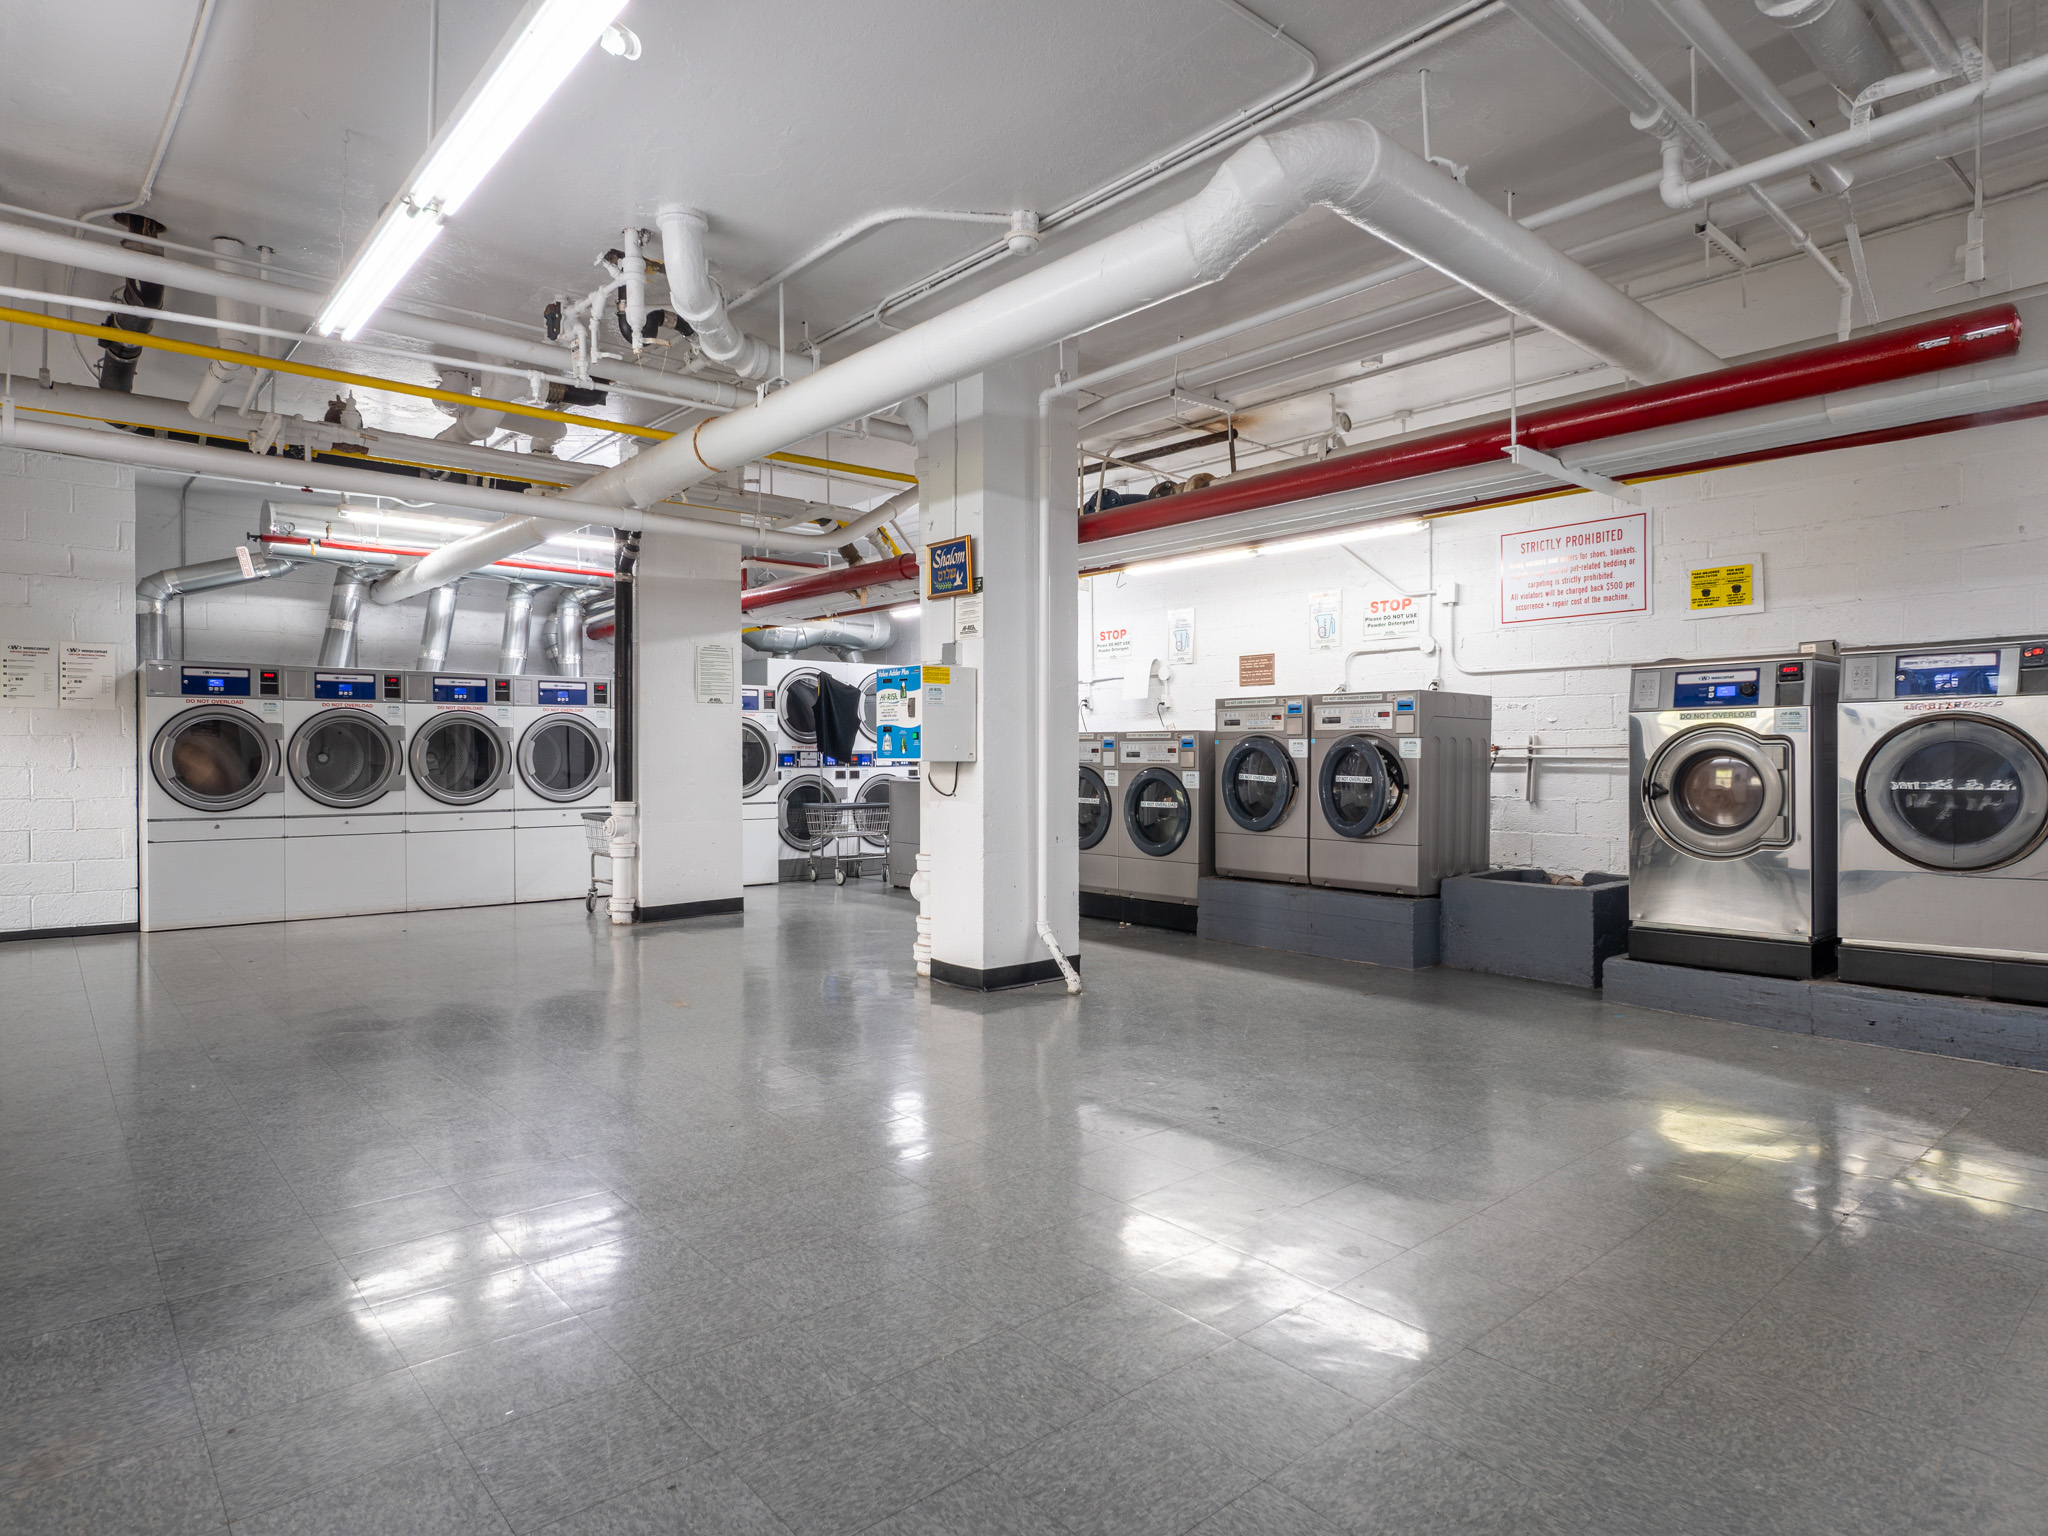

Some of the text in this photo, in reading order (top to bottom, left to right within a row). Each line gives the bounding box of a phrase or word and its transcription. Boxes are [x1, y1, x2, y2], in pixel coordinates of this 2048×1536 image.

[1521, 528, 1623, 554] STRICTLY PROHIBITED
[933, 547, 965, 569] Shalom
[1590, 550, 1608, 558] shoes,
[938, 567, 956, 581] שלום
[1570, 562, 1600, 573] pet-related
[1603, 559, 1626, 568] bedding
[1528, 580, 1552, 589] carpeting
[1562, 575, 1581, 584] strictly
[1584, 571, 1615, 583] prohibited.
[1520, 591, 1543, 600] violators
[1566, 586, 1588, 596] charged
[1590, 583, 1604, 592] back
[1606, 581, 1623, 591] $500
[1626, 581, 1635, 590] per
[1370, 598, 1412, 613] STOP
[1515, 601, 1544, 612] occurrence
[1552, 599, 1568, 608] repair
[1571, 597, 1582, 605] cost
[1591, 595, 1601, 603] the
[1603, 594, 1630, 602] machine.
[1100, 629, 1127, 641] STOP
